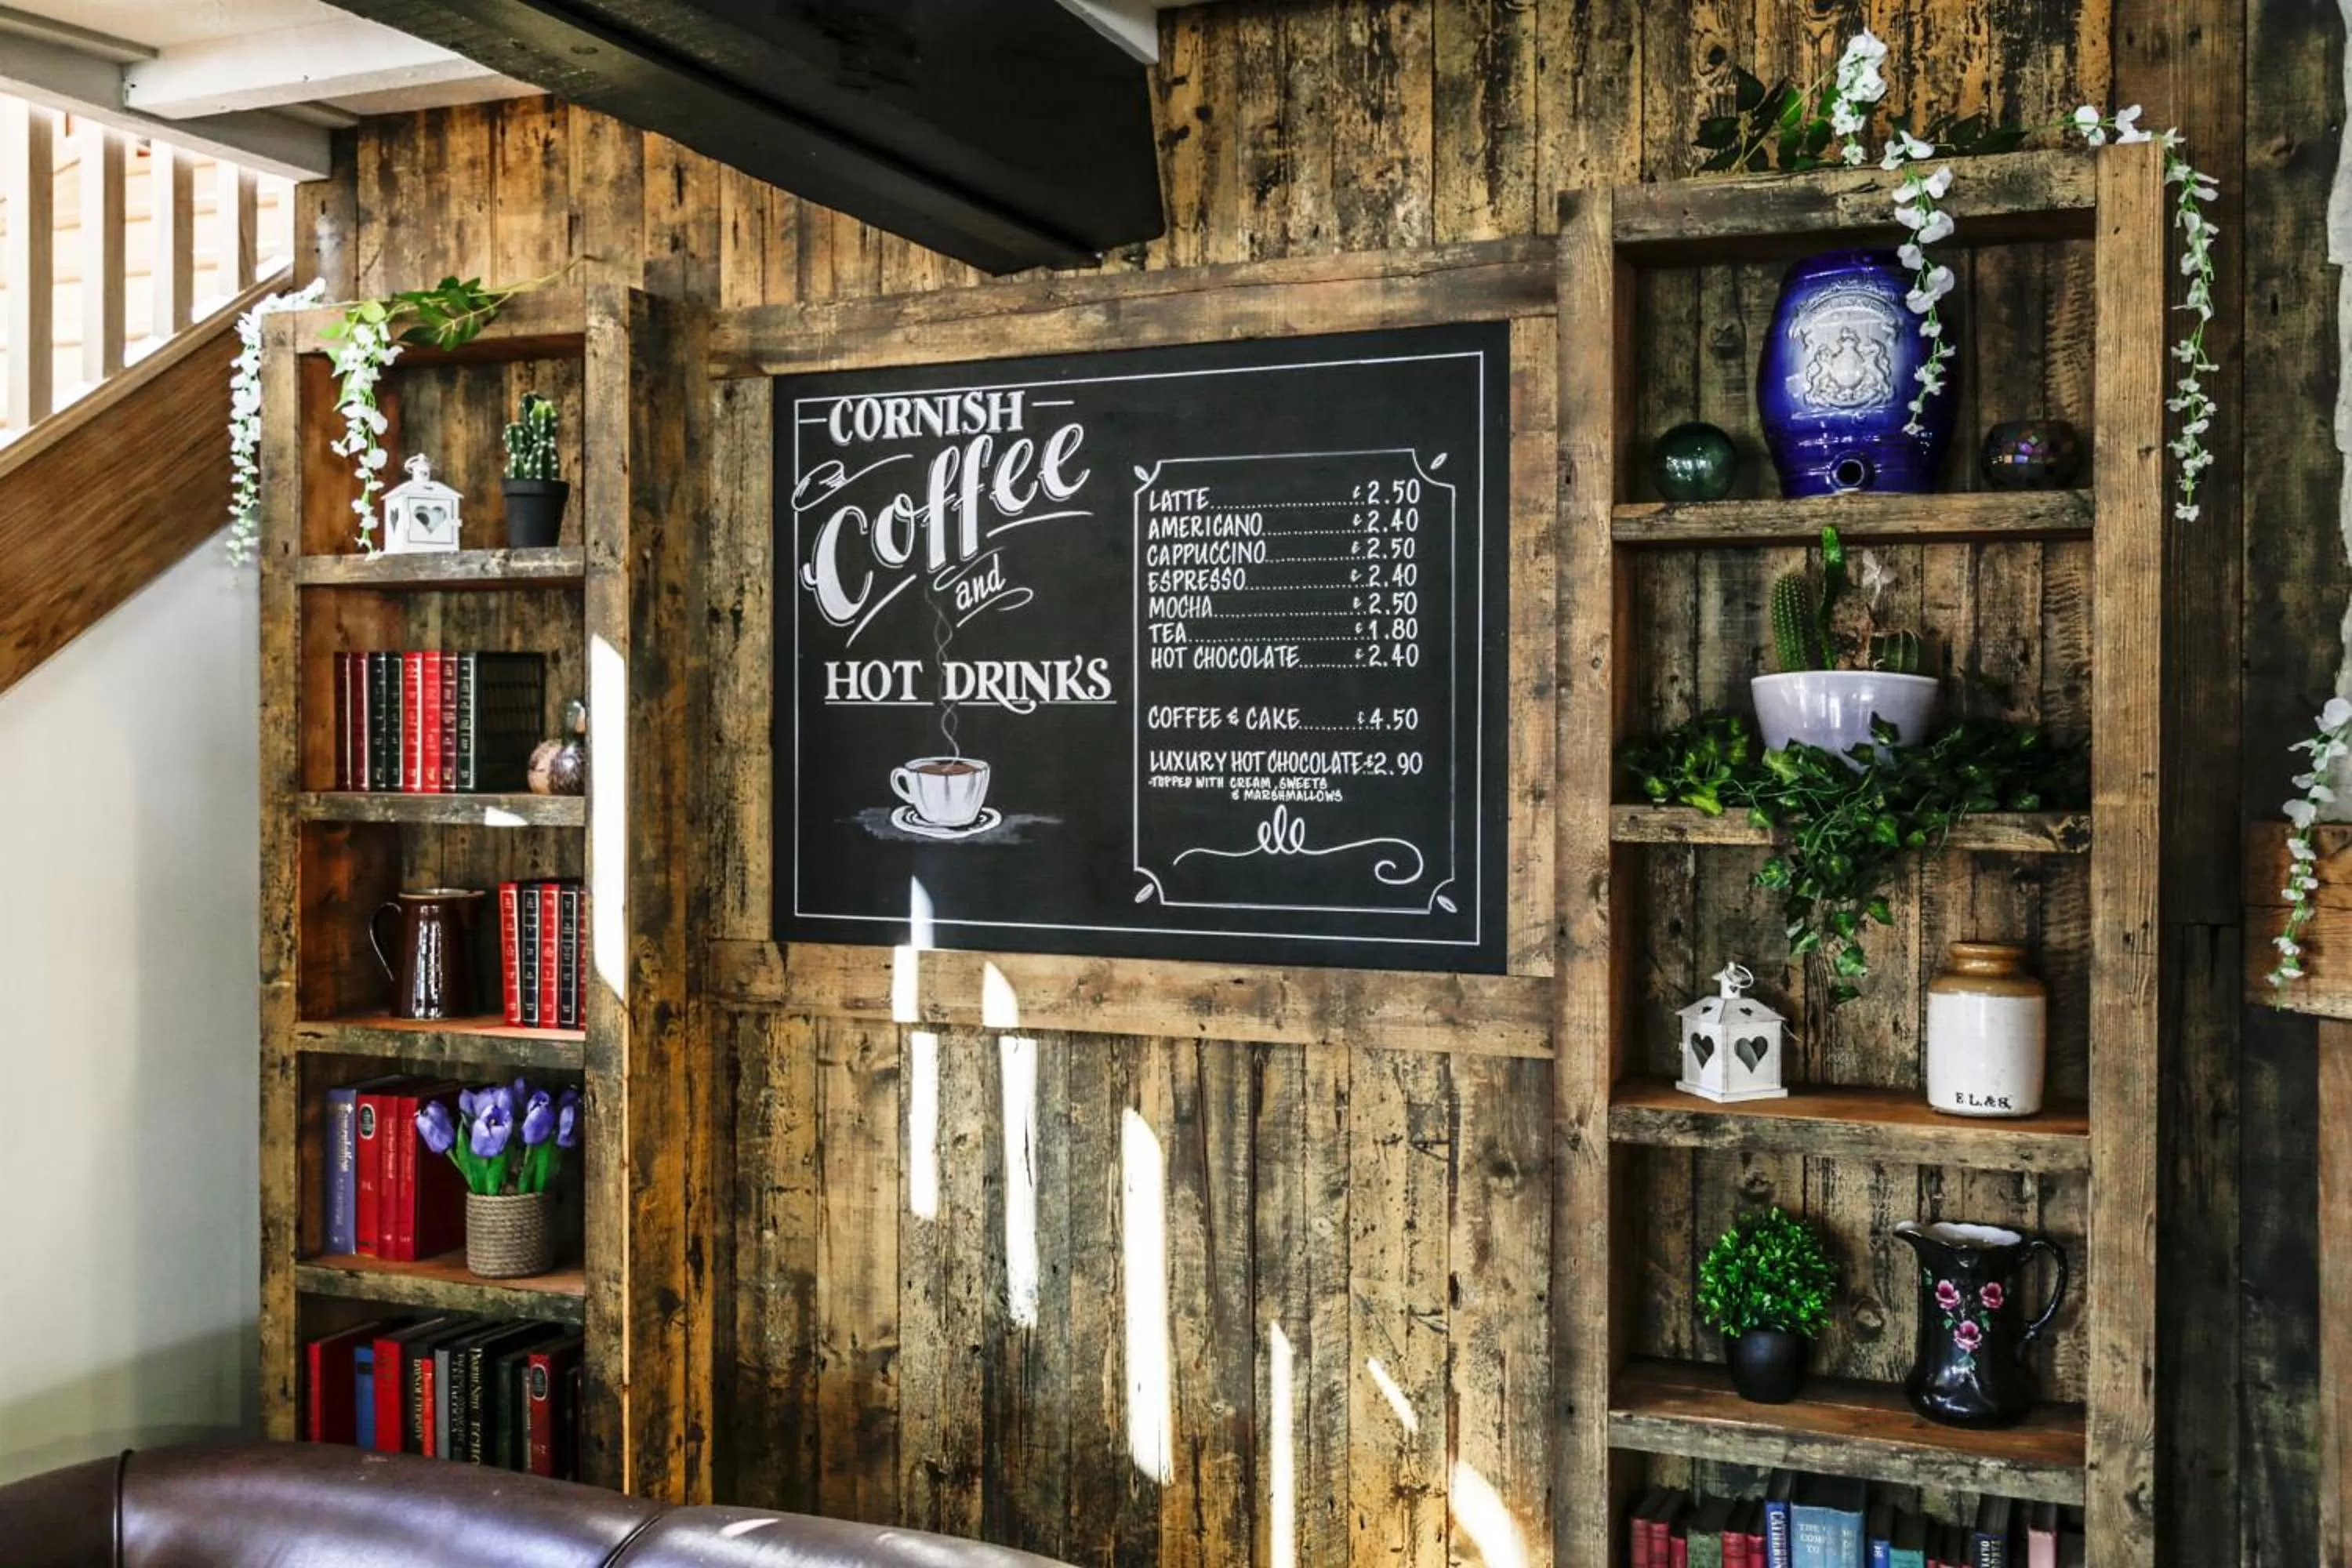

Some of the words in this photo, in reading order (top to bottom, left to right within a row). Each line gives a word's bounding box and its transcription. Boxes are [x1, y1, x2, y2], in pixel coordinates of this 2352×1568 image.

[829, 390, 1025, 445] CORNISH
[1148, 486, 1210, 513] LATTE
[799, 423, 1091, 626] Coffee
[1148, 512, 1264, 541] AMERICANO
[1146, 539, 1267, 567] CAPPUCCINO
[954, 553, 1007, 611] and
[1147, 567, 1247, 593] ESPRESSO
[1148, 595, 1214, 619] MOCHA
[1147, 622, 1188, 644] TEA
[1150, 646, 1189, 670] HOT
[1192, 644, 1301, 670] CHOCOLATE
[825, 659, 924, 701] HOT
[1147, 705, 1222, 729] COFFEE
[1245, 706, 1301, 731] CAKE
[1149, 750, 1228, 773] LUXURY
[1230, 750, 1267, 774] HOT
[1266, 749, 1363, 776] CHOCOLATE
[1195, 775, 1225, 789] WITH
[1243, 789, 1344, 803] MARSHMALLOWS
